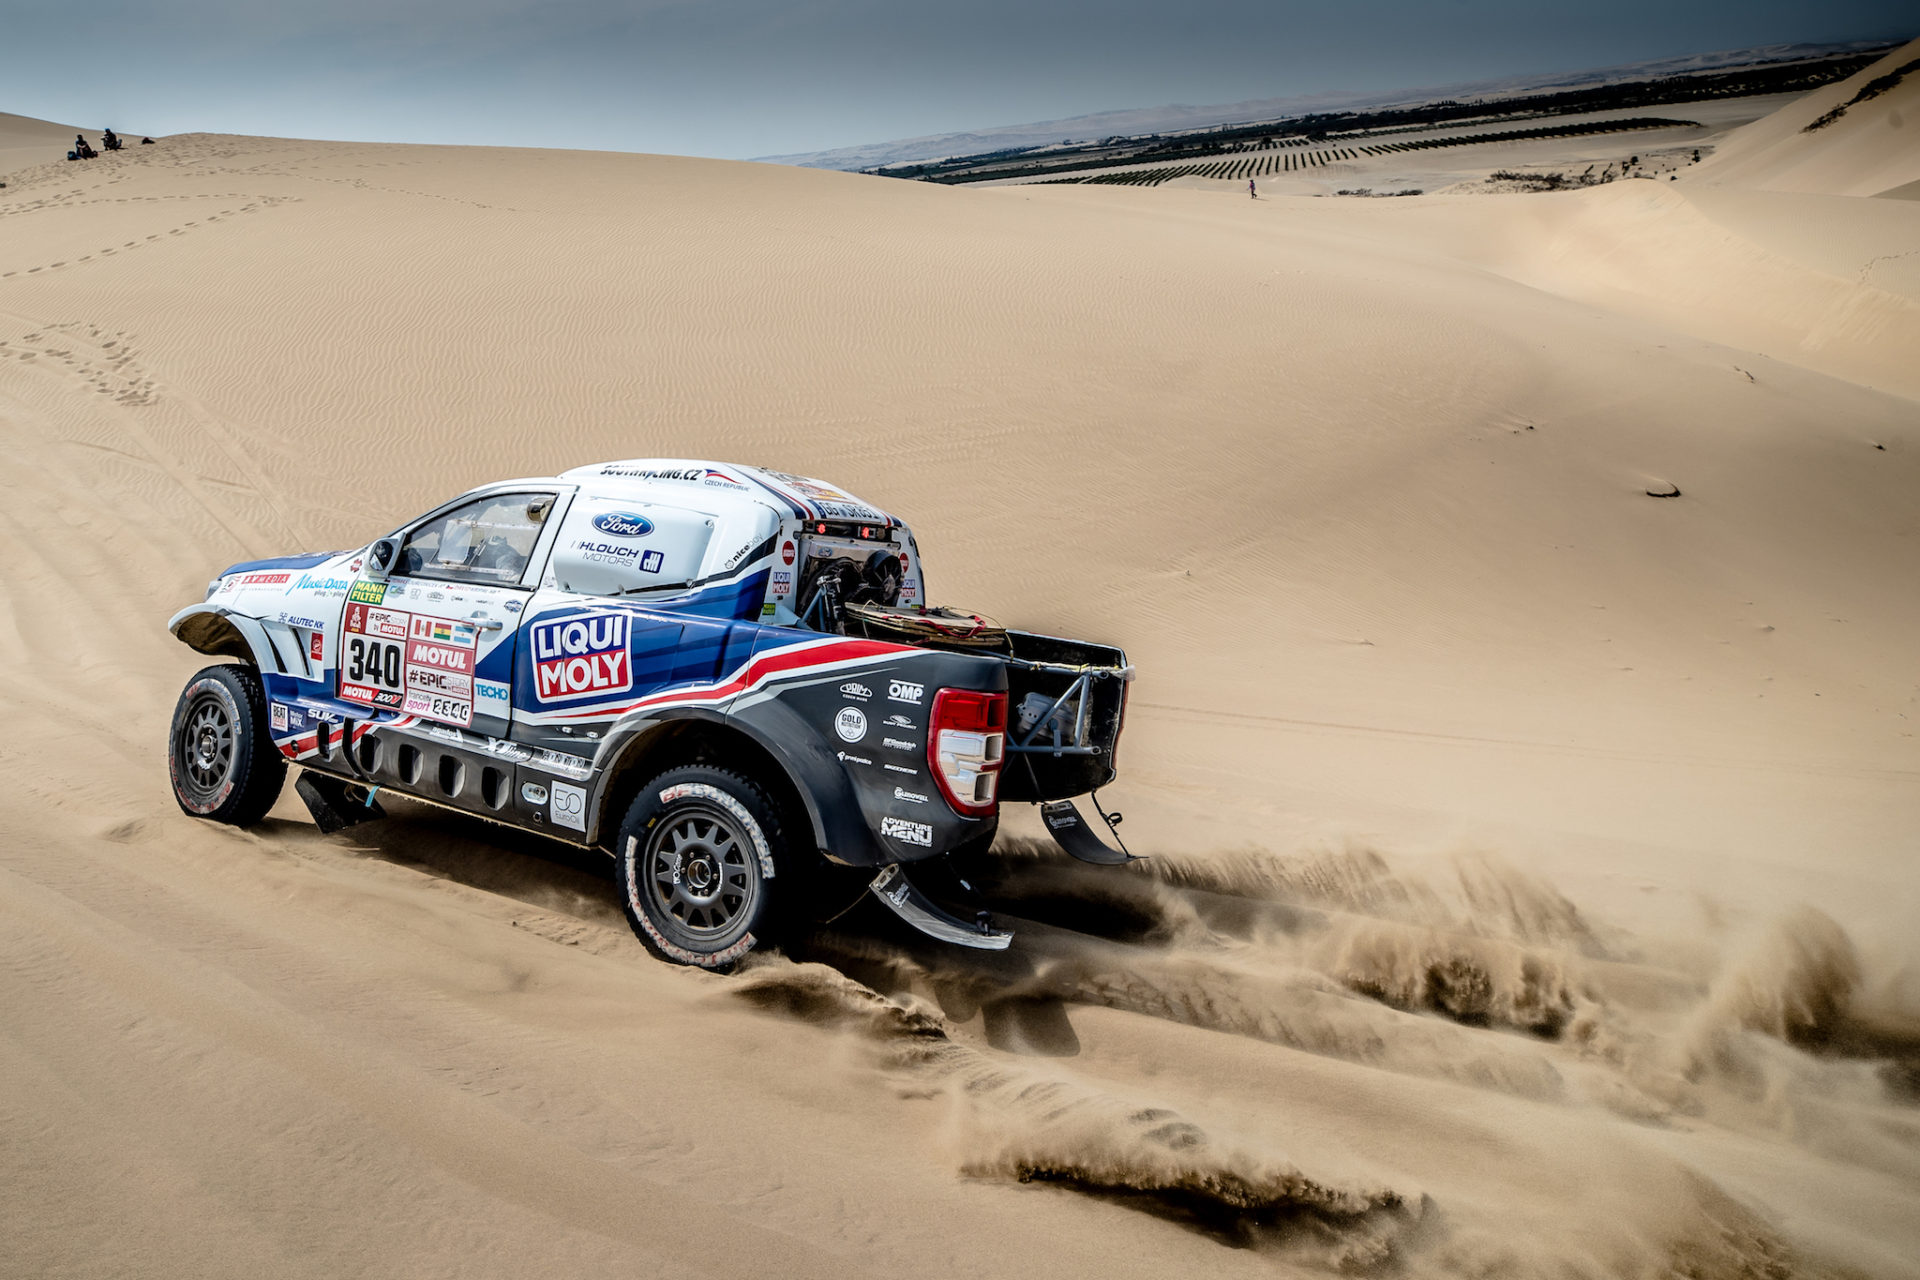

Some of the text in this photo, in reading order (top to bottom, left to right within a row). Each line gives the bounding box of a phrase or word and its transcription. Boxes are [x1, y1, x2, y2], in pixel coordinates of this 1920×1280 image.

[723, 481, 751, 491] REPUBLIC
[601, 512, 643, 535] Ford
[580, 541, 639, 558] HLOUCH
[582, 552, 634, 567] MOTORS
[773, 572, 790, 583] LIQUI
[355, 582, 386, 594] MANN
[773, 583, 790, 593] MOLY
[351, 591, 382, 604] FILTER
[288, 616, 325, 629] ALUTEC KK
[381, 624, 405, 635] MOTUL
[538, 616, 623, 659] LIQUI
[349, 638, 400, 688] 340
[413, 644, 466, 669] MOTUL
[540, 651, 625, 695] MOLY
[343, 684, 401, 704] MOTUL 300V
[888, 683, 923, 700] OMP
[273, 706, 286, 717] BEAT
[407, 699, 430, 712] sport
[841, 714, 862, 724] GOLD
[884, 764, 918, 774] SKECHERS
[883, 816, 932, 831] ADVENTURE
[881, 823, 932, 844] MENU
